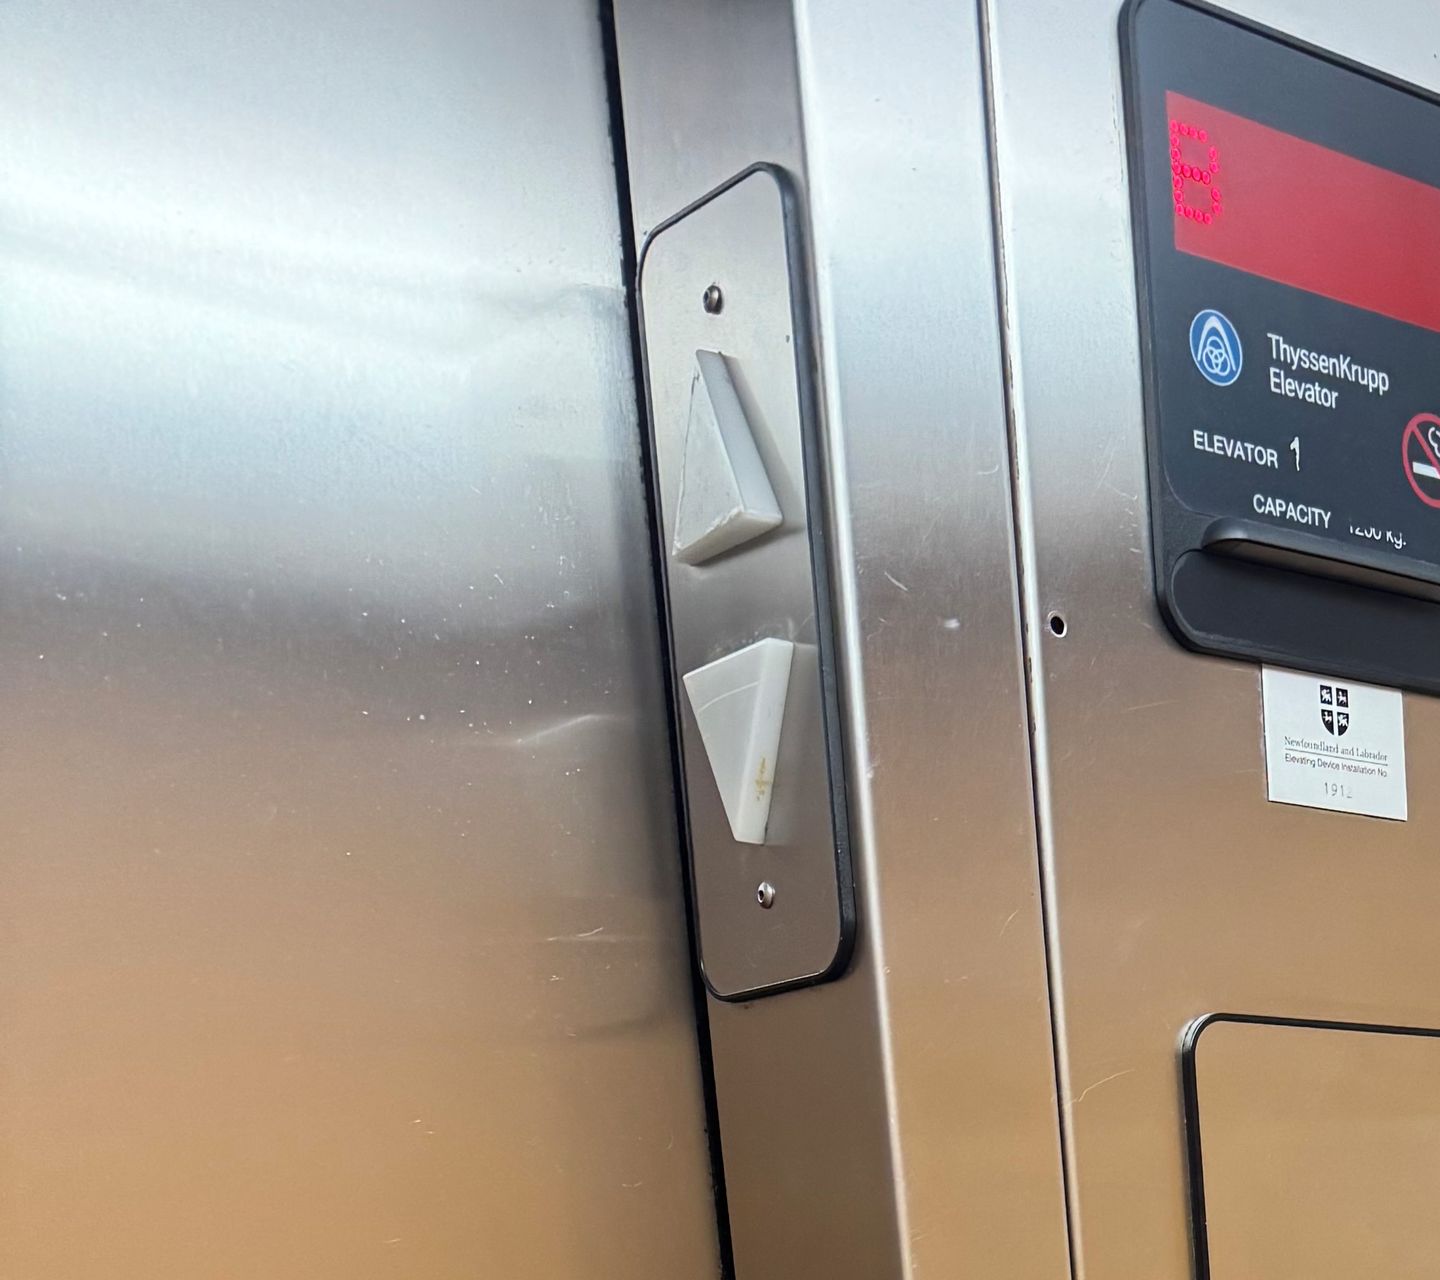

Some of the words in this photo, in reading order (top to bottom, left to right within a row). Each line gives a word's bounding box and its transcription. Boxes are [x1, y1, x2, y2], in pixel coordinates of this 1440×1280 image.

[1267, 332, 1389, 396] ThyssenKrupp
[1269, 367, 1339, 409] Elevator
[1193, 430, 1278, 469] ELEVATOR
[1290, 436, 1300, 471] 1
[1253, 493, 1331, 529] CAPACITY
[1284, 736, 1339, 754] Newfoundland
[1341, 746, 1354, 757] and
[1356, 750, 1387, 761] Labrador
[1285, 753, 1316, 768] Elevating
[1318, 758, 1340, 771] Device
[1341, 763, 1376, 776] Installation
